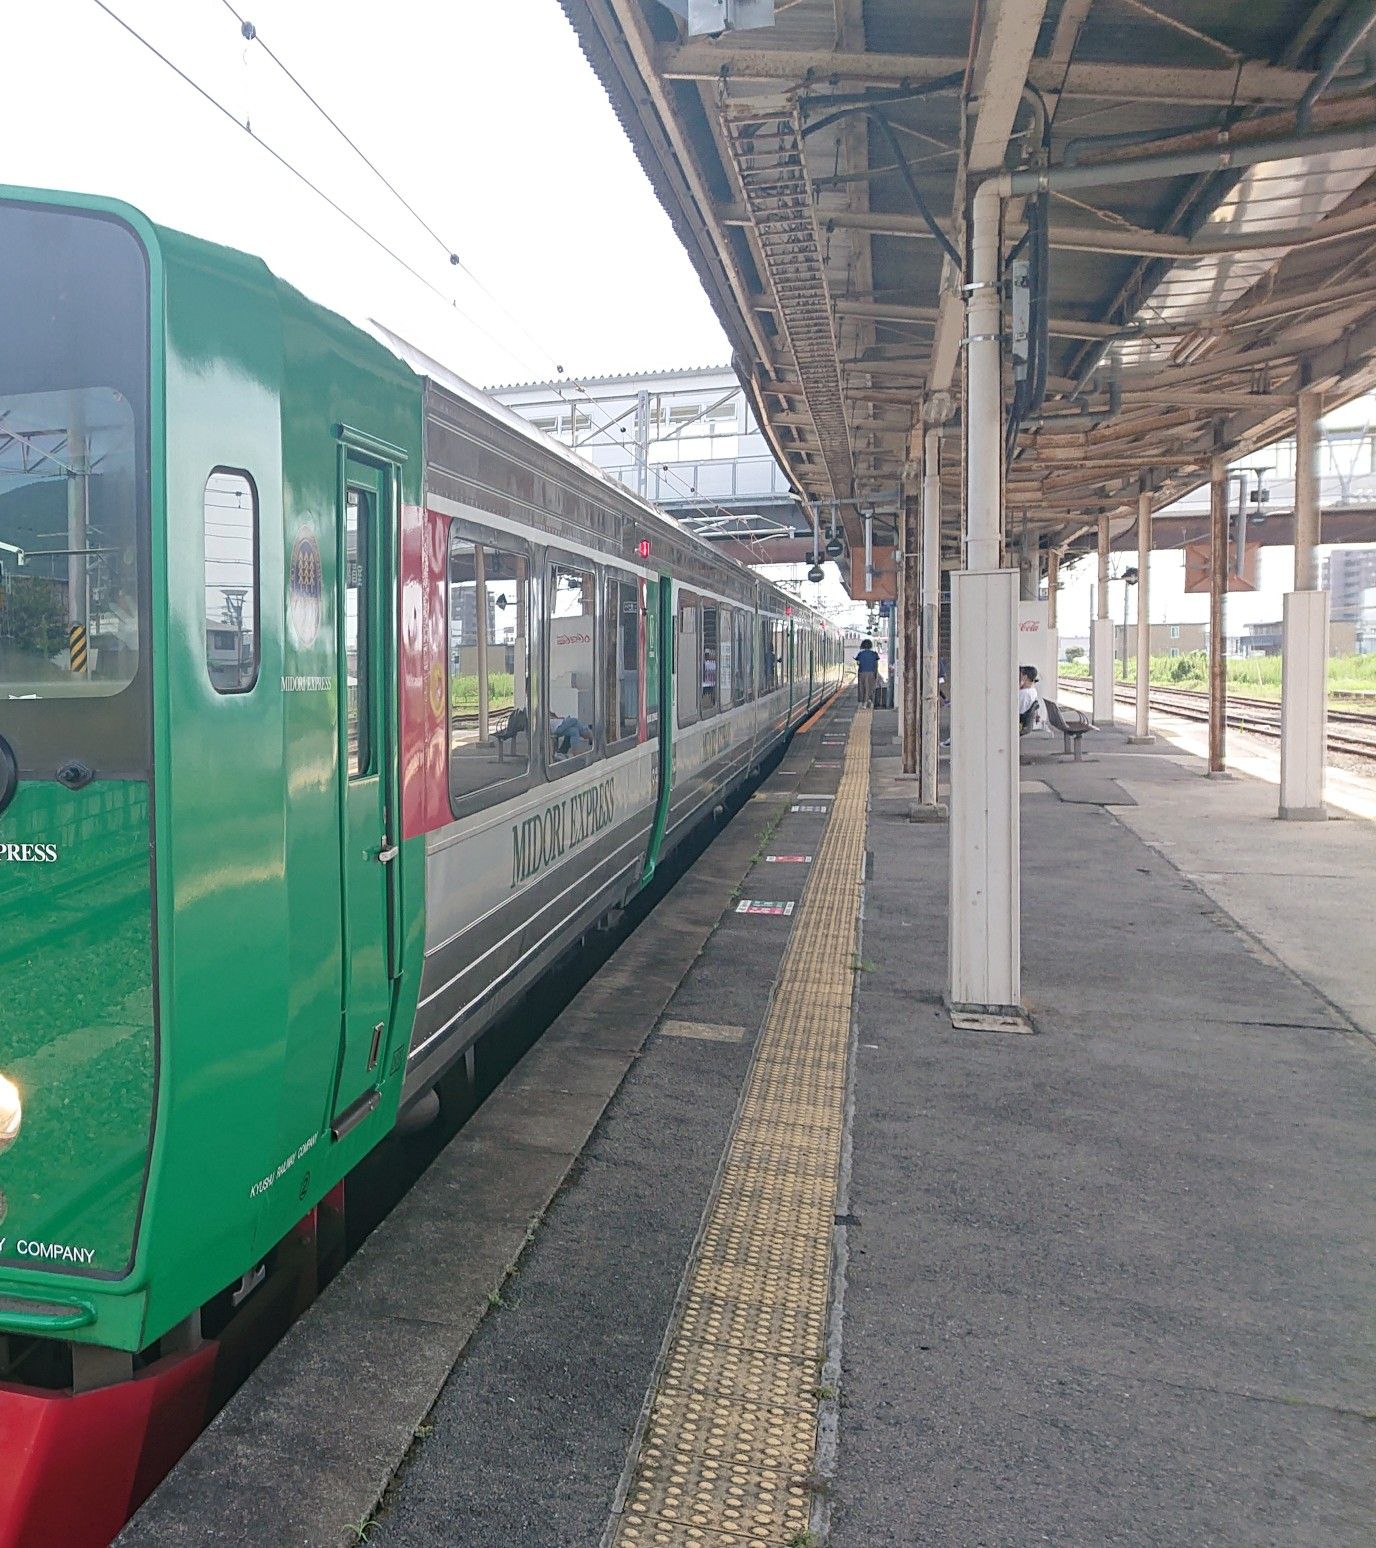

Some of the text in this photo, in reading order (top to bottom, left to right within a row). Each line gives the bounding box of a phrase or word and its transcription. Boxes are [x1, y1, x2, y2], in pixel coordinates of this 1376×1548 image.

[280, 676, 332, 691] MIDORI EXPRESS
[510, 777, 615, 888] MIDORI EXPRESS
[16, 1239, 96, 1264] COMPANY
